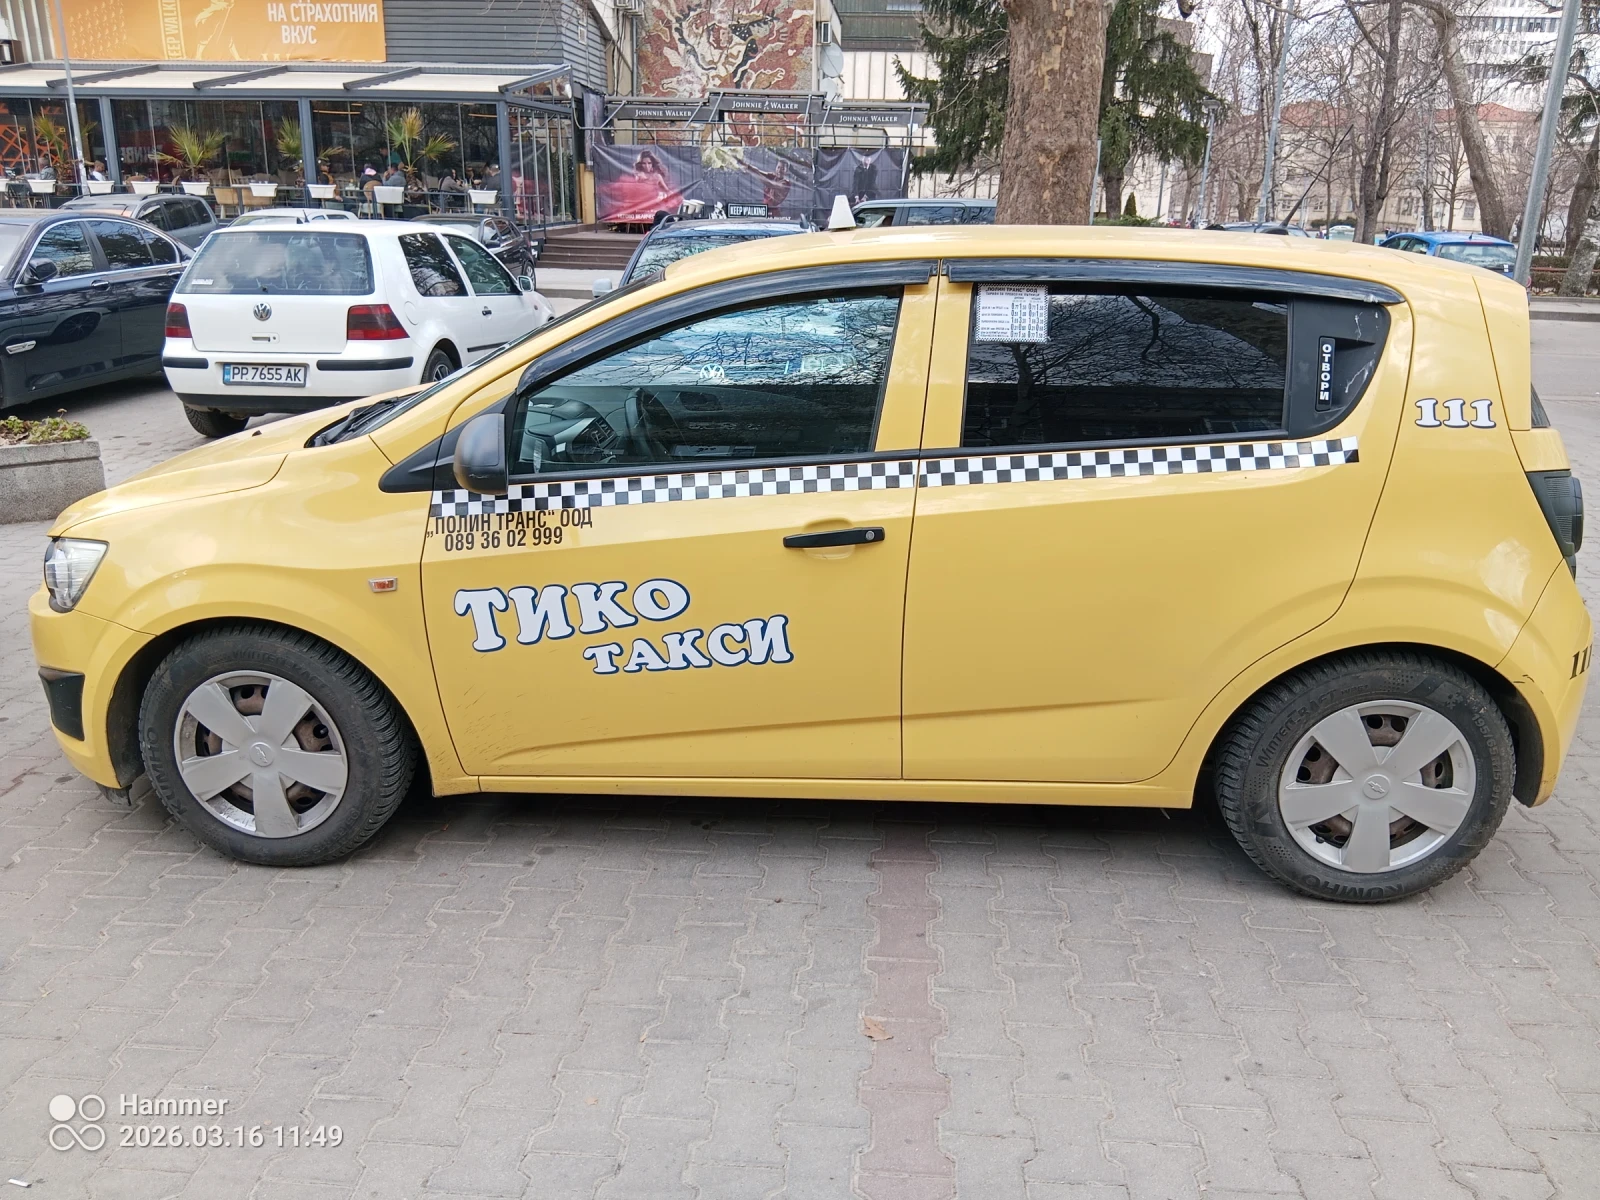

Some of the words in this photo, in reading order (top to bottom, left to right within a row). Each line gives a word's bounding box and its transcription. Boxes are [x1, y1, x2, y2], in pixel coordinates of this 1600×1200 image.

[267, 3, 288, 22] НА
[290, 3, 379, 23] СТРАХОТНИЯ
[281, 25, 317, 44] ВКУС
[635, 109, 665, 117] JOHNNIE
[665, 109, 692, 117] WALKER
[732, 100, 762, 109] JOHNNIE
[770, 102, 799, 110] WALKER
[730, 205, 743, 215] KEEP
[743, 206, 766, 216] WALKING
[251, 367, 282, 381] 7655
[285, 368, 302, 382] AK
[1319, 344, 1332, 401] ОТВОРИ
[1415, 398, 1497, 429] 111
[560, 507, 593, 529] ООД
[444, 532, 475, 552] 089
[480, 530, 501, 550] 36
[506, 529, 526, 548] 02
[532, 526, 563, 546] 999
[454, 578, 690, 652] ТИКО
[583, 615, 794, 674] ТАКСИ
[1301, 874, 1405, 899] KUMHO
